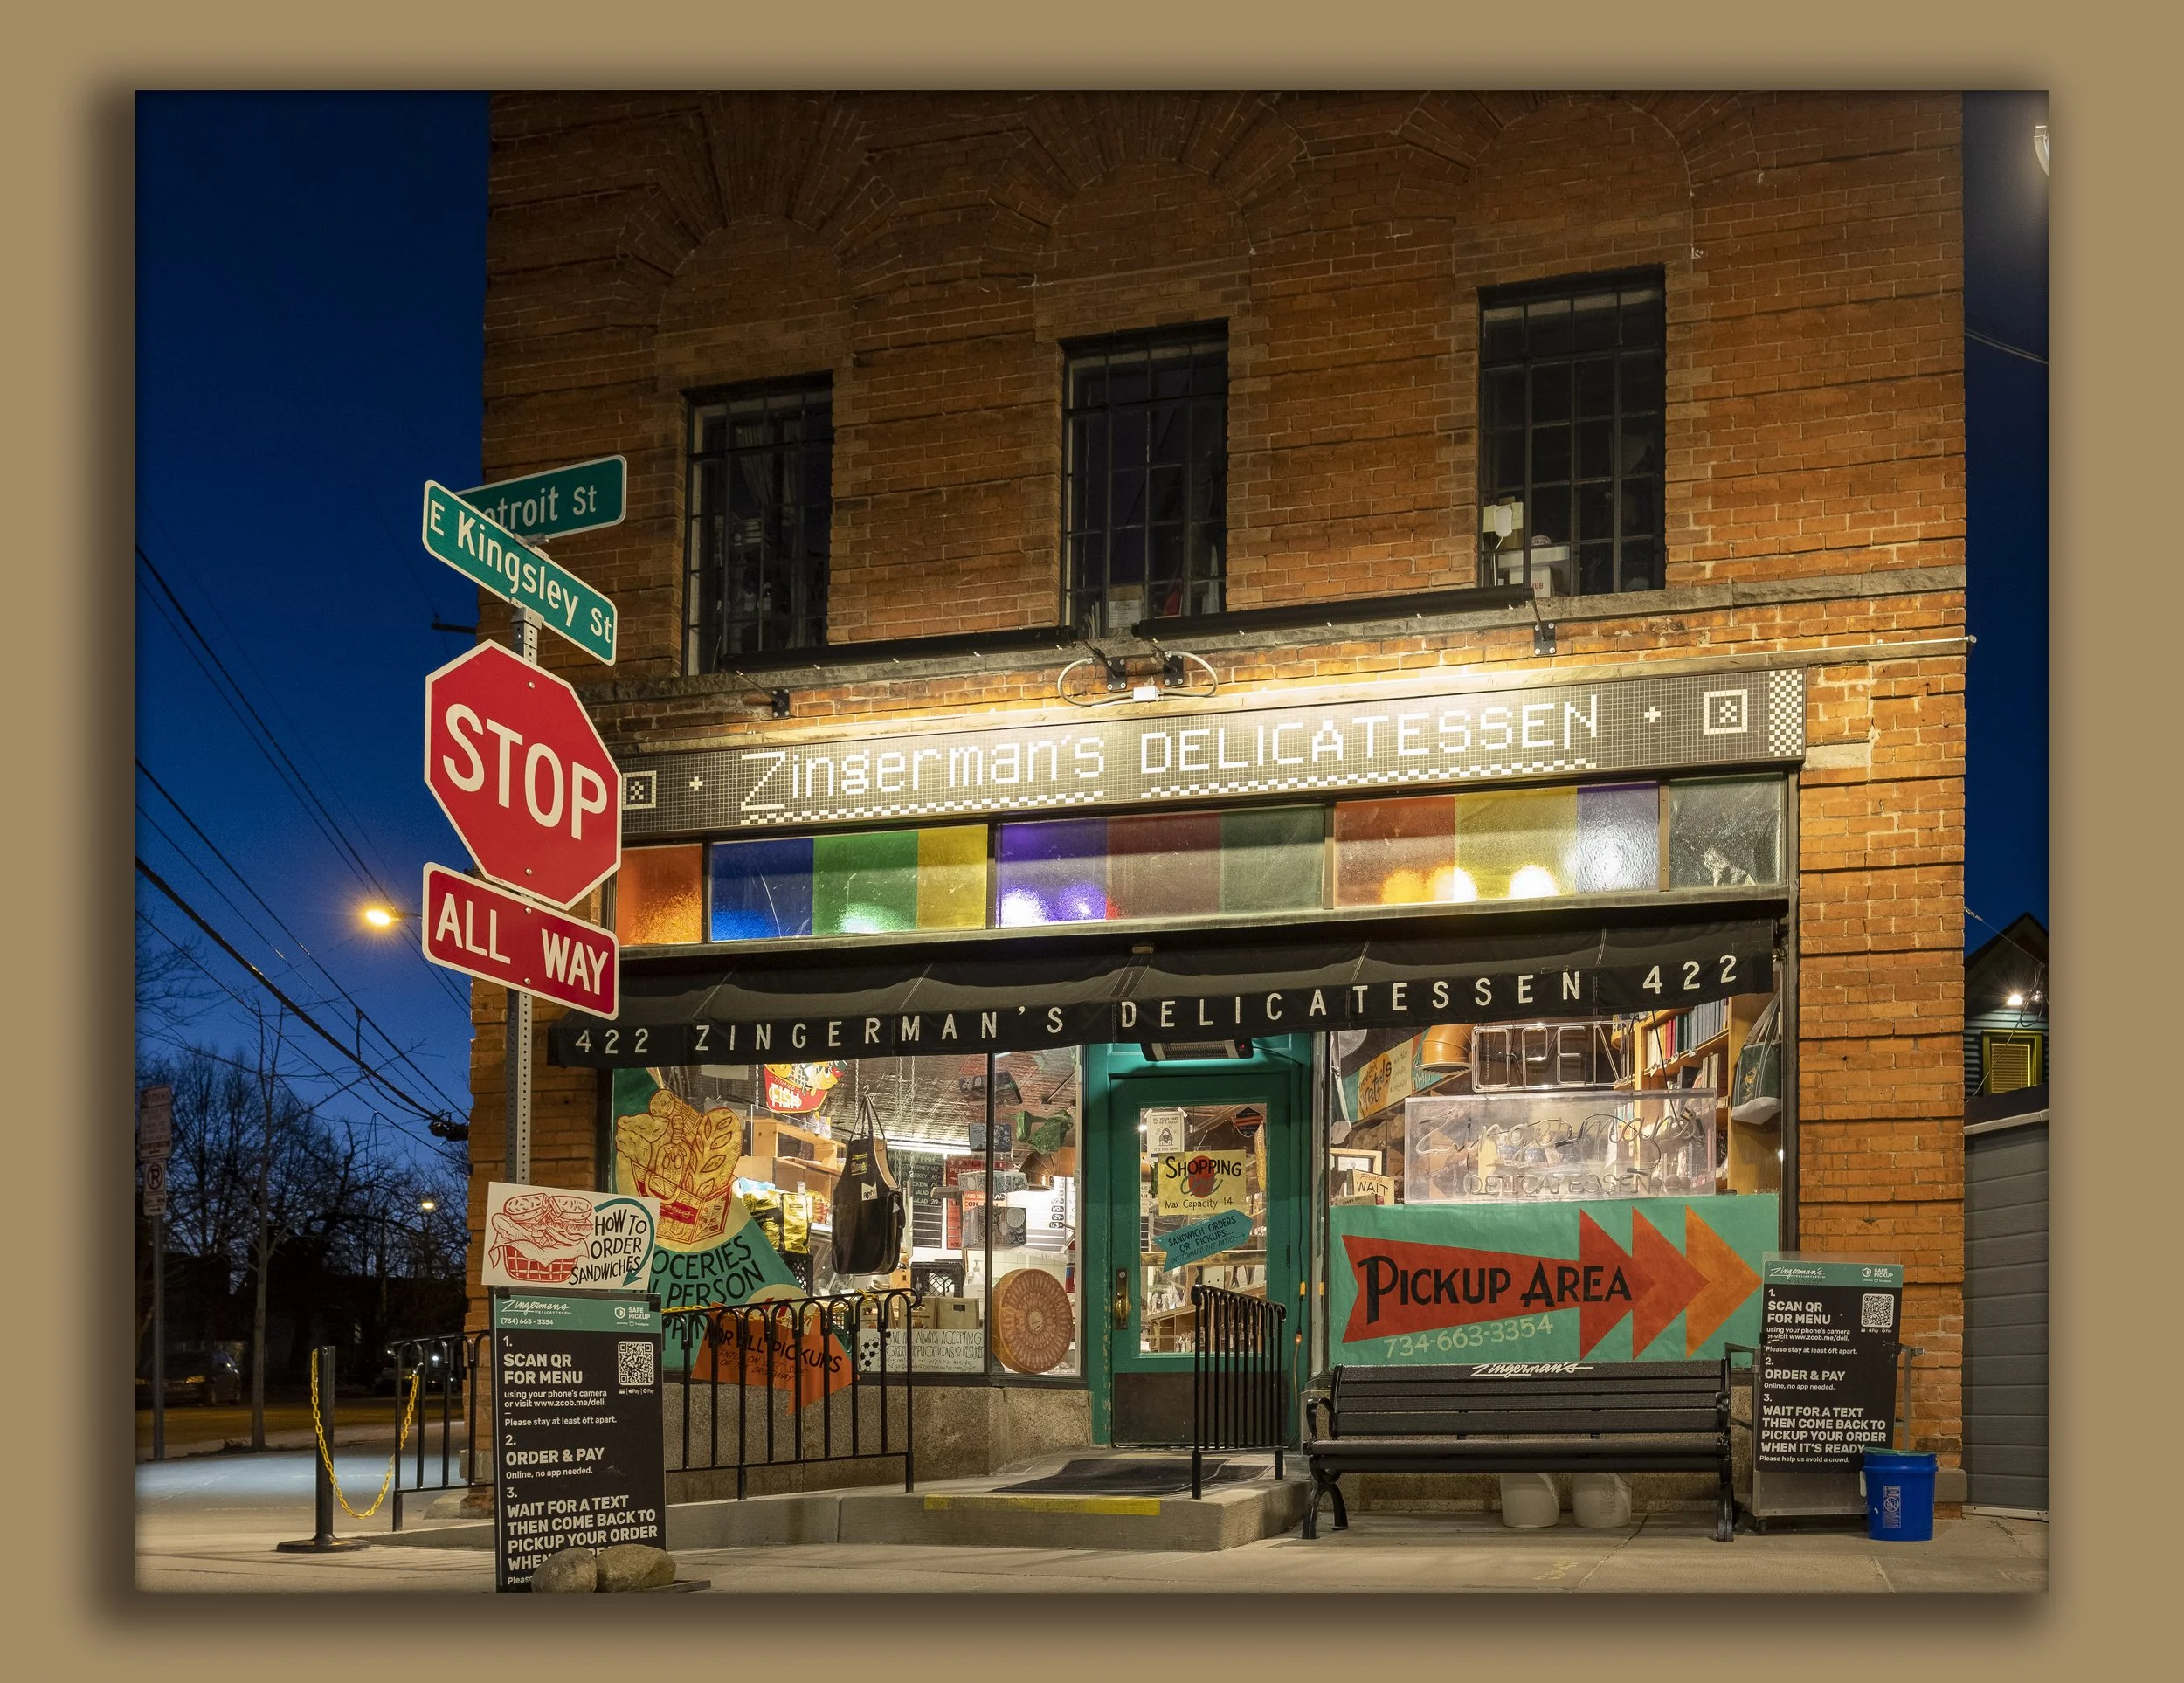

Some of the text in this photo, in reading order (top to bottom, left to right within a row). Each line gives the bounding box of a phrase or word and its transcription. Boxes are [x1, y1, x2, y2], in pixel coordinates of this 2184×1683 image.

[573, 485, 597, 515] St
[430, 500, 612, 644] E Kingsley St
[740, 694, 1598, 811] Zingerman's DELICATESSEN
[442, 703, 608, 841] STOP
[435, 893, 609, 995] ALL WAY
[575, 955, 1739, 1055] 422 ZINGERMAN'S DELICATESSEN 422
[1165, 1155, 1242, 1179] SHOPPING
[1356, 1181, 1388, 1196] WAIT
[1165, 1200, 1179, 1209] Max
[1223, 1197, 1234, 1205] 14
[595, 1209, 647, 1236] HOW TO
[1168, 1215, 1236, 1247] SANDWICH ORDERS
[591, 1237, 642, 1259] ORDER
[1179, 1241, 1191, 1252] OR
[651, 1235, 753, 1280] OCERIES
[568, 1256, 641, 1285] SANDWICHES
[1357, 1255, 1633, 1325] PICKUP AREA
[1768, 1288, 1776, 1297] 1.
[1767, 1300, 1823, 1313] SCAN QR
[1767, 1314, 1831, 1325] FOR MENU
[503, 1335, 513, 1347] 1.
[941, 1330, 983, 1345] ACCEPTING
[1384, 1314, 1554, 1358] 734-663-3354
[503, 1353, 572, 1369] SCAN QR
[504, 1371, 583, 1384] FOR MENU
[1470, 1362, 1594, 1378] Zingerman's
[1765, 1369, 1846, 1381] ORDER & PAY
[504, 1390, 526, 1399] using
[529, 1391, 547, 1401] your
[548, 1390, 578, 1400] phone's
[1763, 1393, 1773, 1403] 3.
[515, 1399, 533, 1408] visit
[1763, 1405, 1864, 1417] WAIT FOR A TEXT
[504, 1418, 532, 1427] Please
[533, 1417, 550, 1428] stay
[562, 1417, 581, 1425] least
[582, 1416, 594, 1424] 6ft
[595, 1416, 617, 1425] apart.
[1762, 1417, 1886, 1431] THEN COME BACK TO
[505, 1435, 516, 1445] 2.
[1761, 1430, 1886, 1442] PICKUP YOUR ORDER
[1761, 1442, 1797, 1453] WHEN
[1799, 1443, 1822, 1453] IT'S
[506, 1447, 605, 1466] ORDER & PAY
[506, 1470, 534, 1480] Online,
[547, 1469, 562, 1479] app
[563, 1466, 593, 1476] needed.
[506, 1487, 518, 1498] 3.
[507, 1494, 629, 1518] WAIT FOR A TEXT
[507, 1508, 656, 1535] THEN COME BACK TO
[508, 1525, 658, 1554] PICKUP YOUR ORDER
